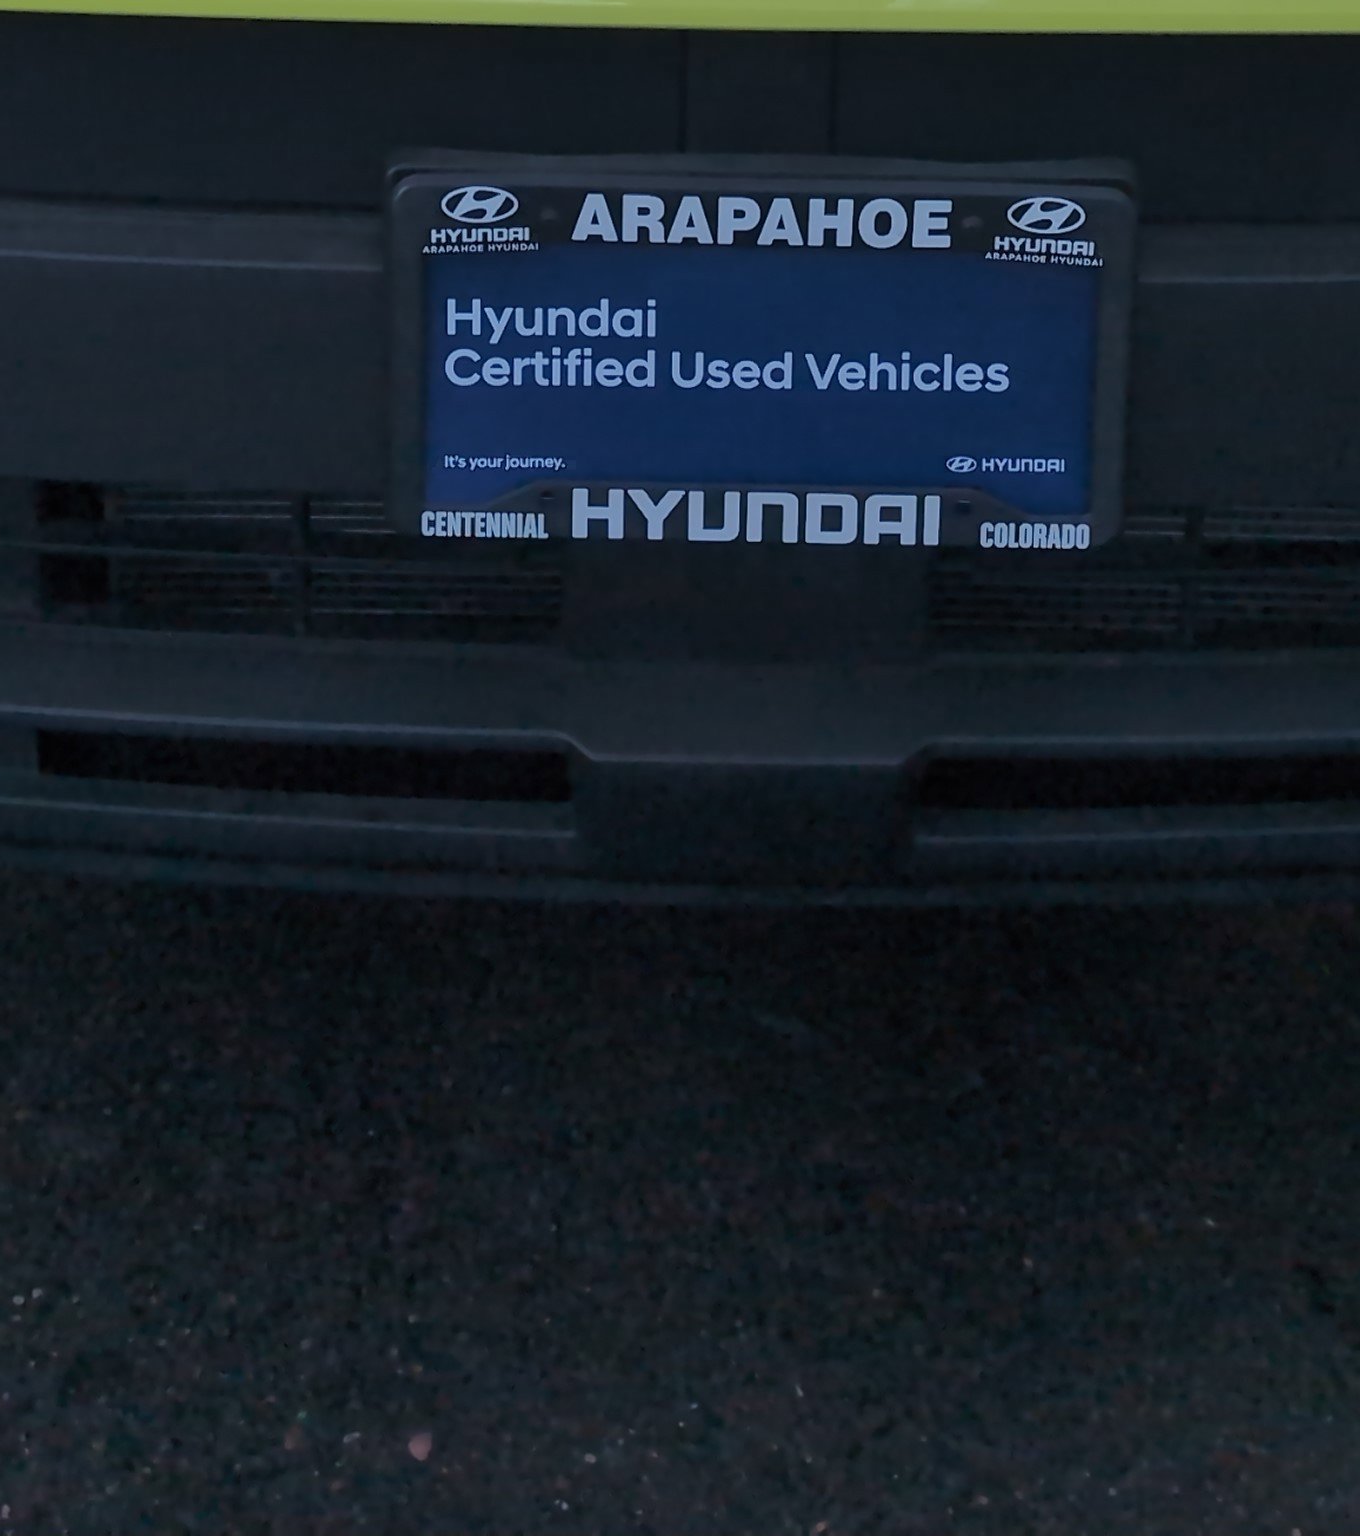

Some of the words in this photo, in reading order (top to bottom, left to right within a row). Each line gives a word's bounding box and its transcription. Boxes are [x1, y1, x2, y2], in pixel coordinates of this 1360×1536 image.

[571, 193, 952, 249] ARAPAHOE
[431, 227, 530, 243] HYUNDAI
[994, 236, 1095, 256] HYUNDAI
[422, 244, 484, 254] ARAPAHOE
[488, 242, 539, 252] HYUNDAI
[985, 251, 1047, 264] ARAPAHOE
[1051, 255, 1103, 268] HYUNDAI
[446, 298, 657, 344] Hyundai
[444, 347, 656, 388] Certified
[671, 351, 793, 390] Used
[804, 351, 1011, 393] Vehicles
[469, 457, 503, 472] your
[504, 454, 567, 472] journey.
[981, 458, 1066, 473] HYUNDAI
[420, 510, 549, 539] CENTENNIAL
[571, 487, 942, 546] HYUNDAI
[979, 521, 1091, 550] COLORADO
